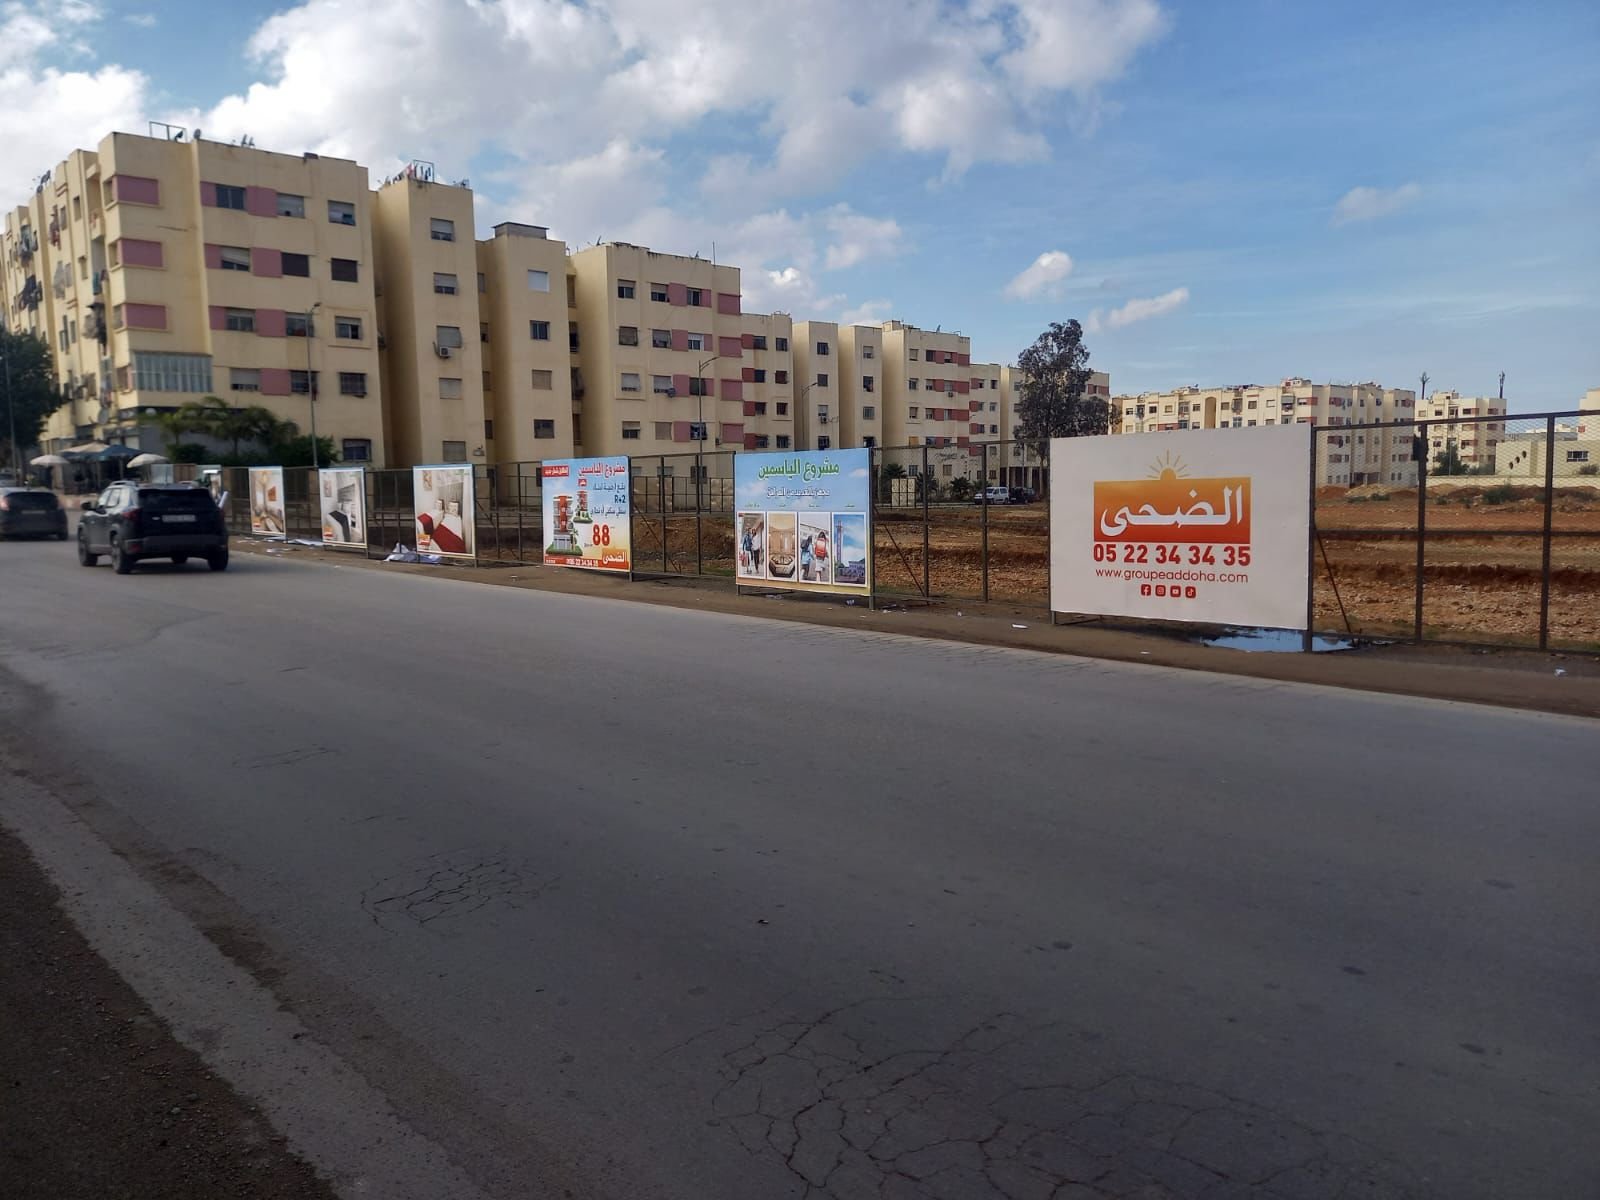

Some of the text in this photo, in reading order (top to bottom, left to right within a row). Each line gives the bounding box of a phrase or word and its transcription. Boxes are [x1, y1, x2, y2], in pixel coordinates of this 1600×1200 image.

[578, 461, 625, 478] مشروع الياسمين
[758, 457, 840, 481] مشروع الياسمين
[1100, 484, 1243, 537] الضحى
[592, 524, 611, 546] 88
[602, 551, 627, 564] الضحى
[1093, 543, 1251, 566] 05 22 34 34 35
[1095, 568, 1248, 583] www.groupeaddoha.com
